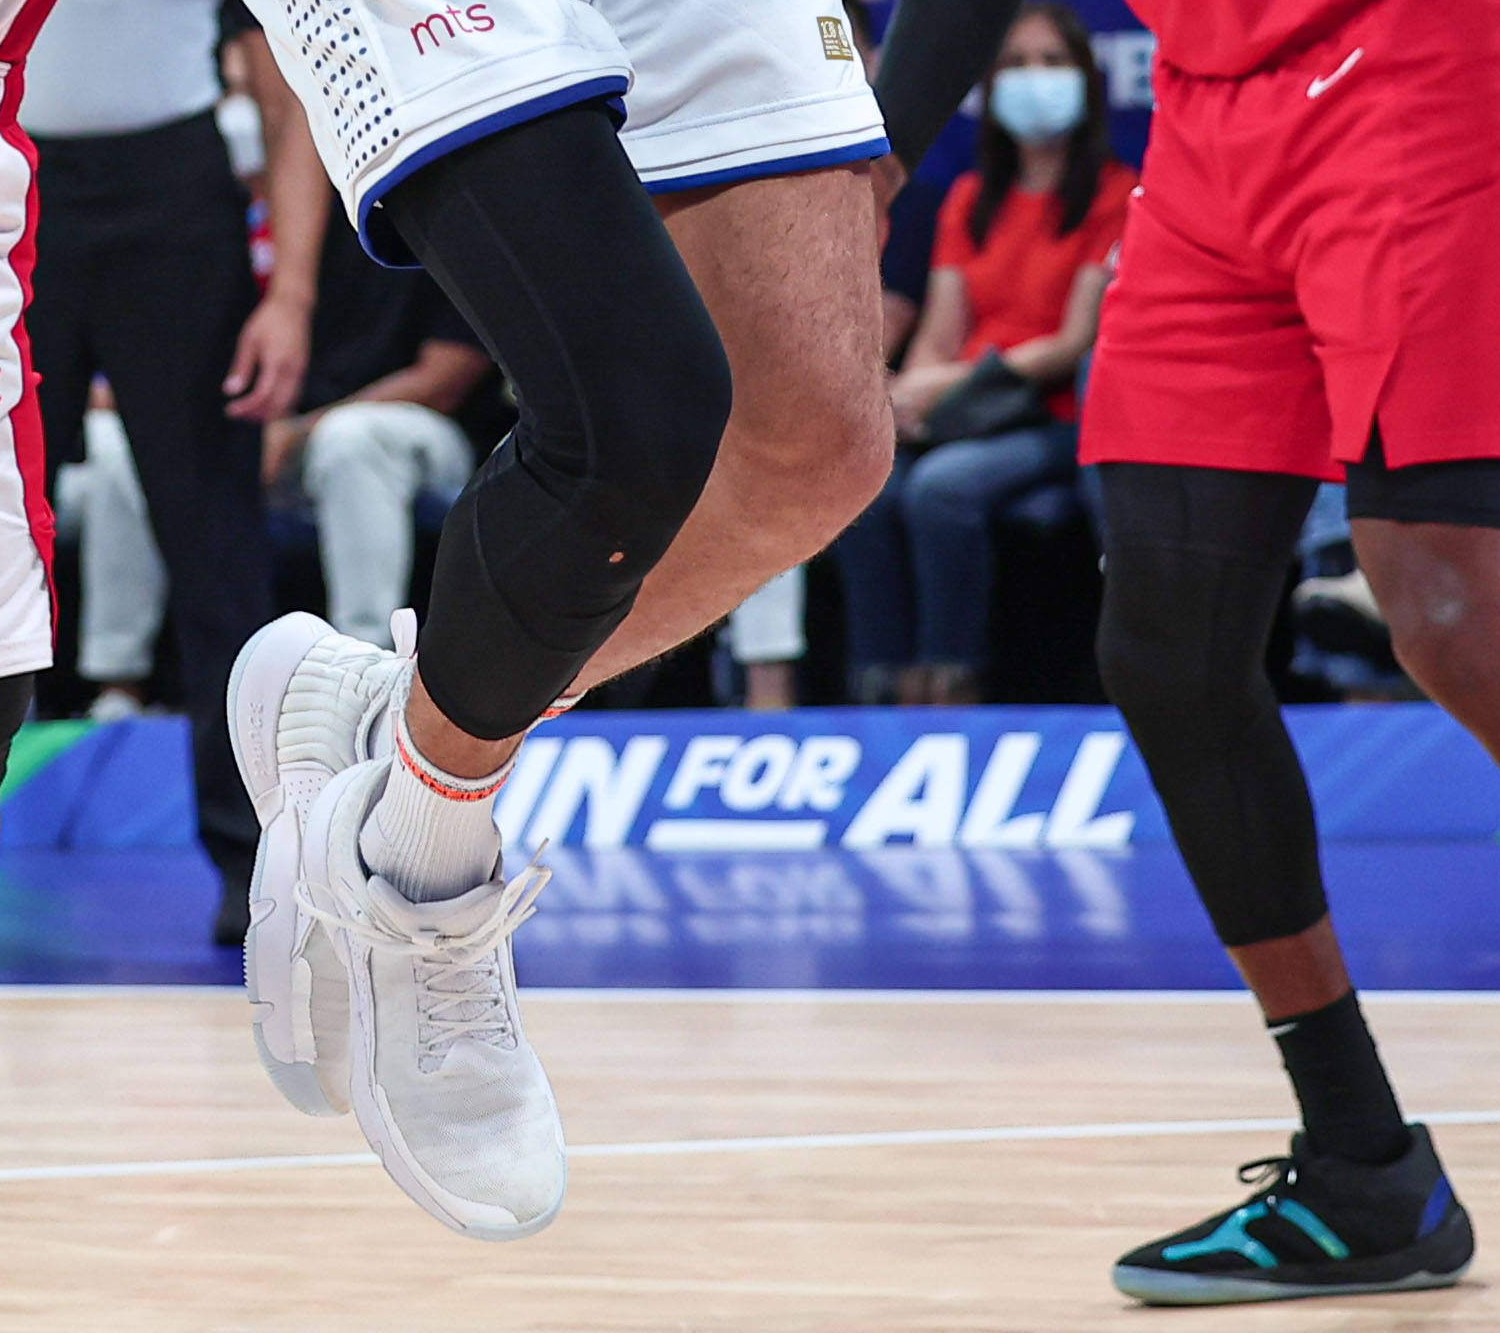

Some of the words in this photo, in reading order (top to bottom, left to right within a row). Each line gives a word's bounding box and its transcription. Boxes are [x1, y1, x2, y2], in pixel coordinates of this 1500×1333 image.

[410, 1, 495, 55] mts
[663, 733, 862, 810] FOR
[840, 733, 1135, 847] ALL
